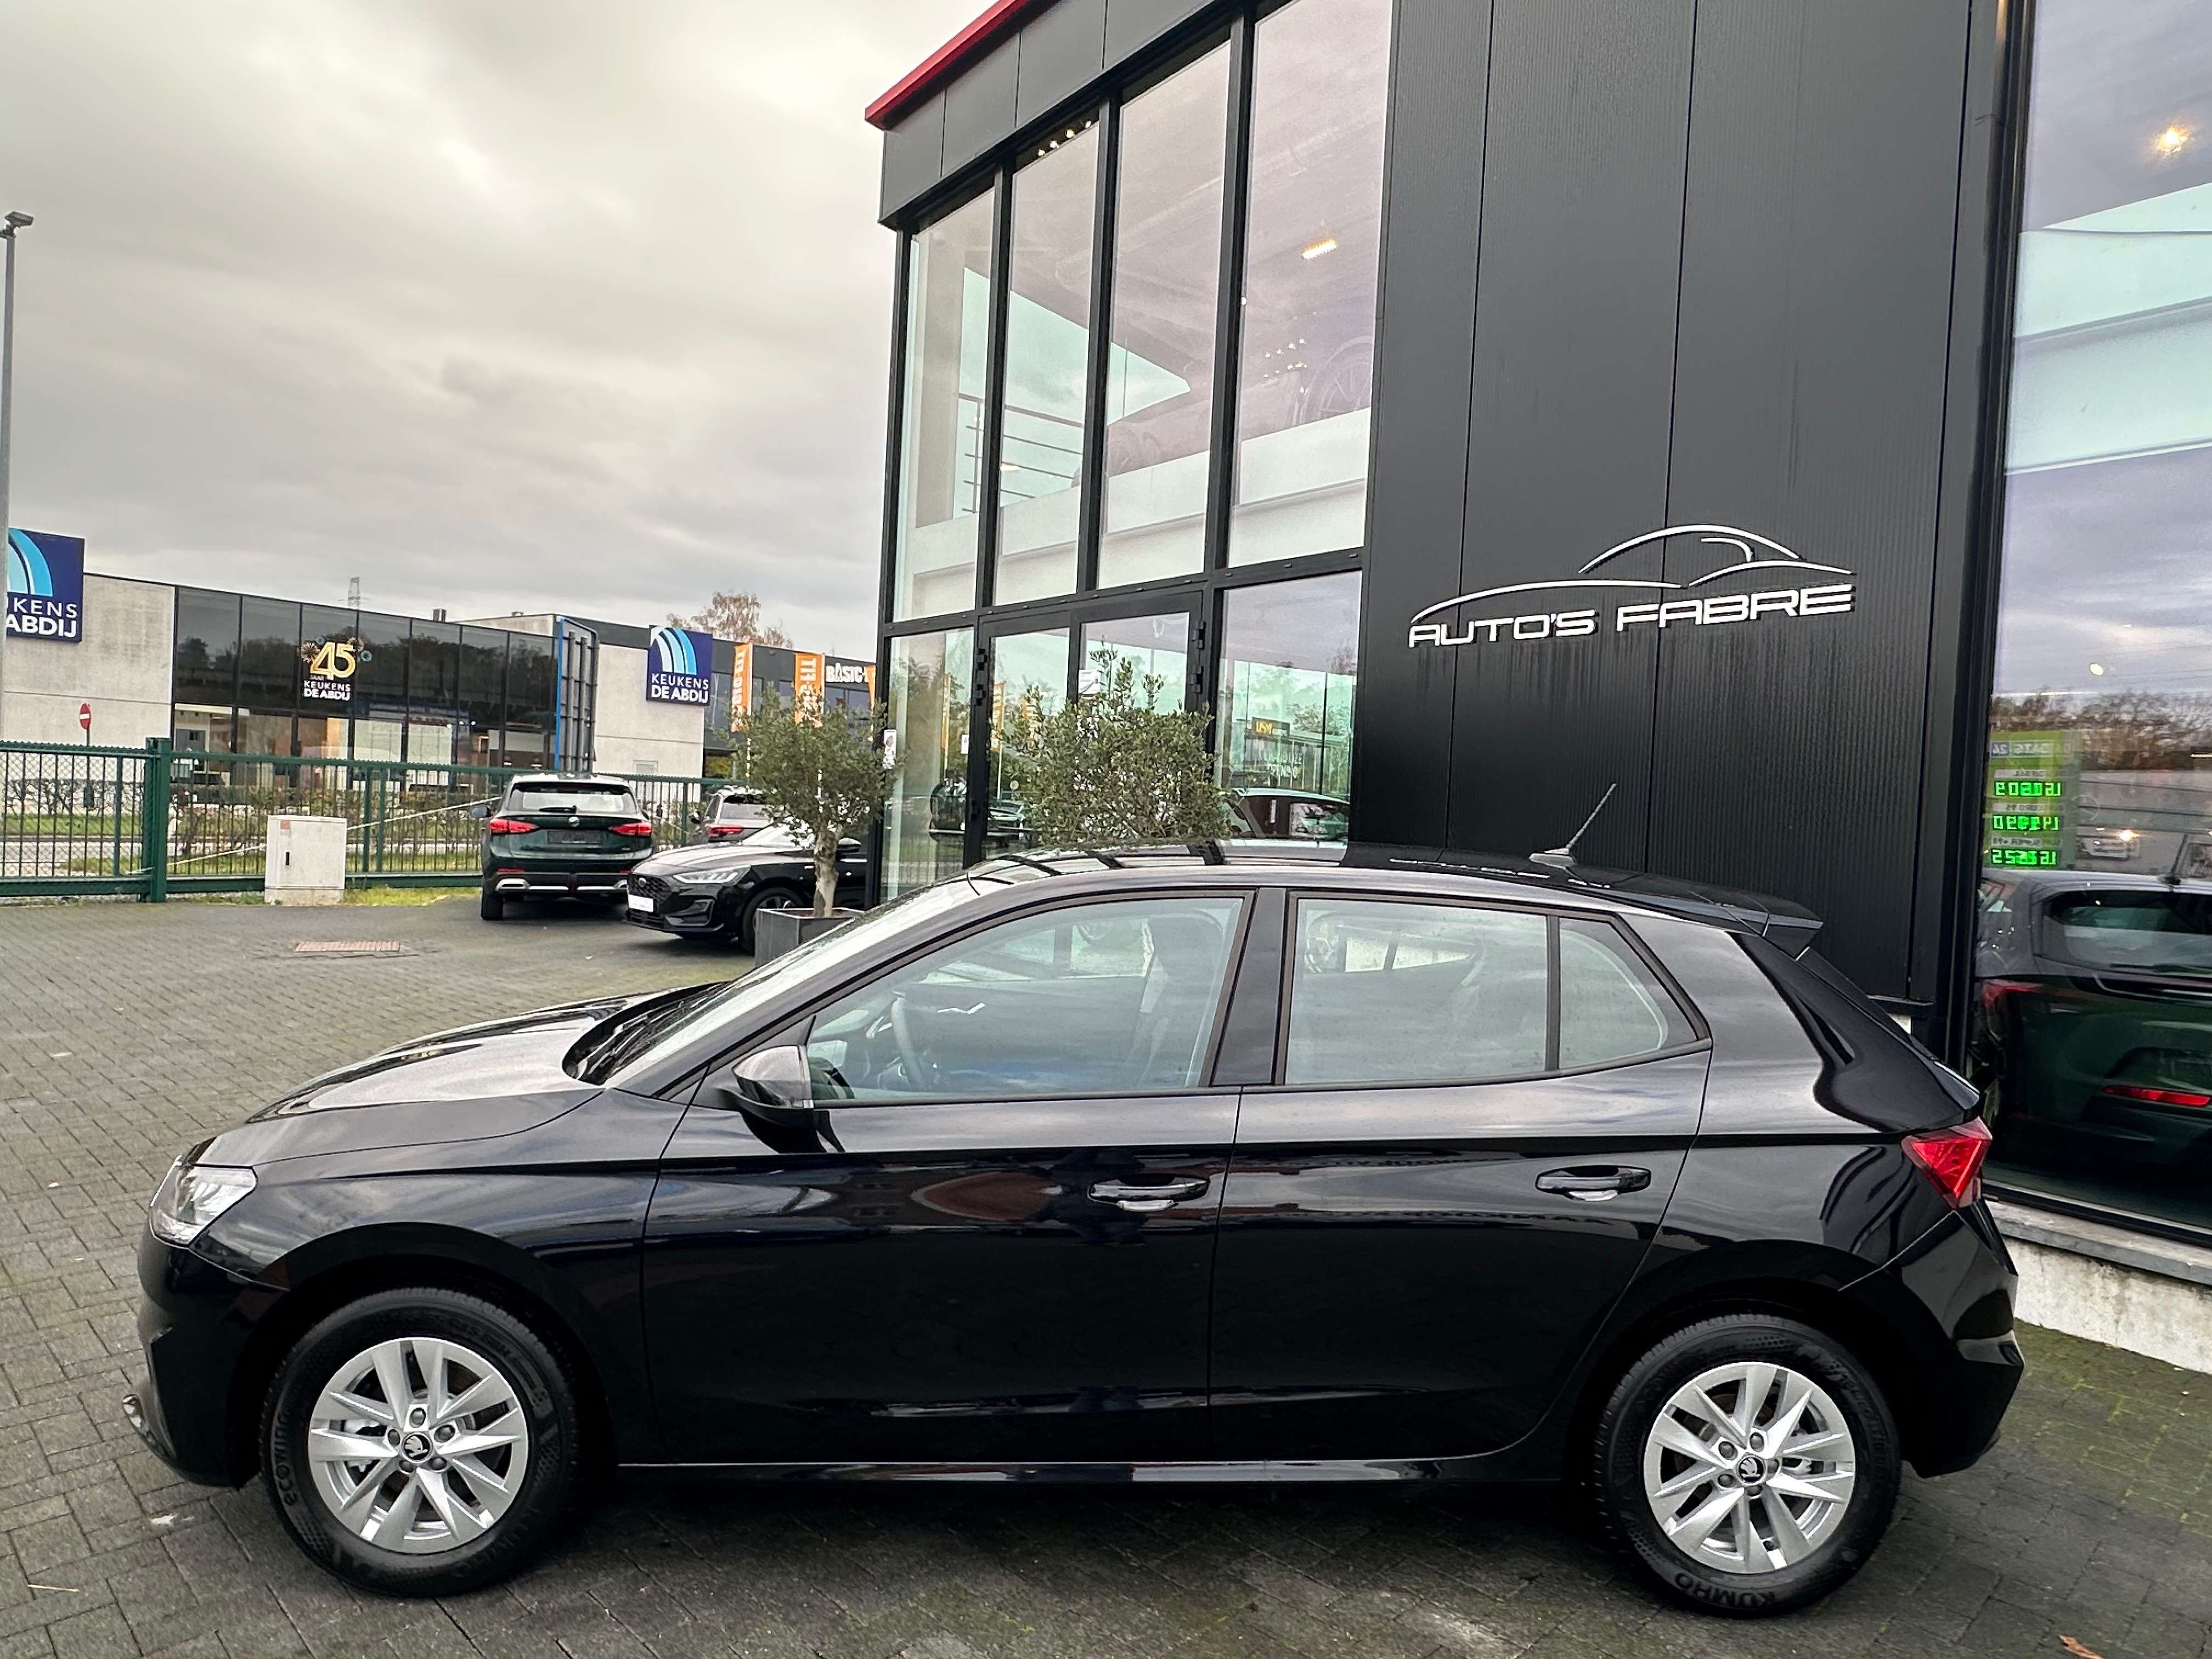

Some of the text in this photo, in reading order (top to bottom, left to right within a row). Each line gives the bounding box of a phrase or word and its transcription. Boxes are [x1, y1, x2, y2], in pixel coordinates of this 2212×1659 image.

[5, 613, 77, 637] ABDIJ
[1408, 583, 1855, 648] AUTO'S FABRE
[309, 641, 356, 680] 45
[304, 680, 351, 692] KEUKENS
[651, 673, 709, 690] KEUKENS
[303, 688, 319, 698] DE
[651, 684, 709, 703] DE ABDIJ
